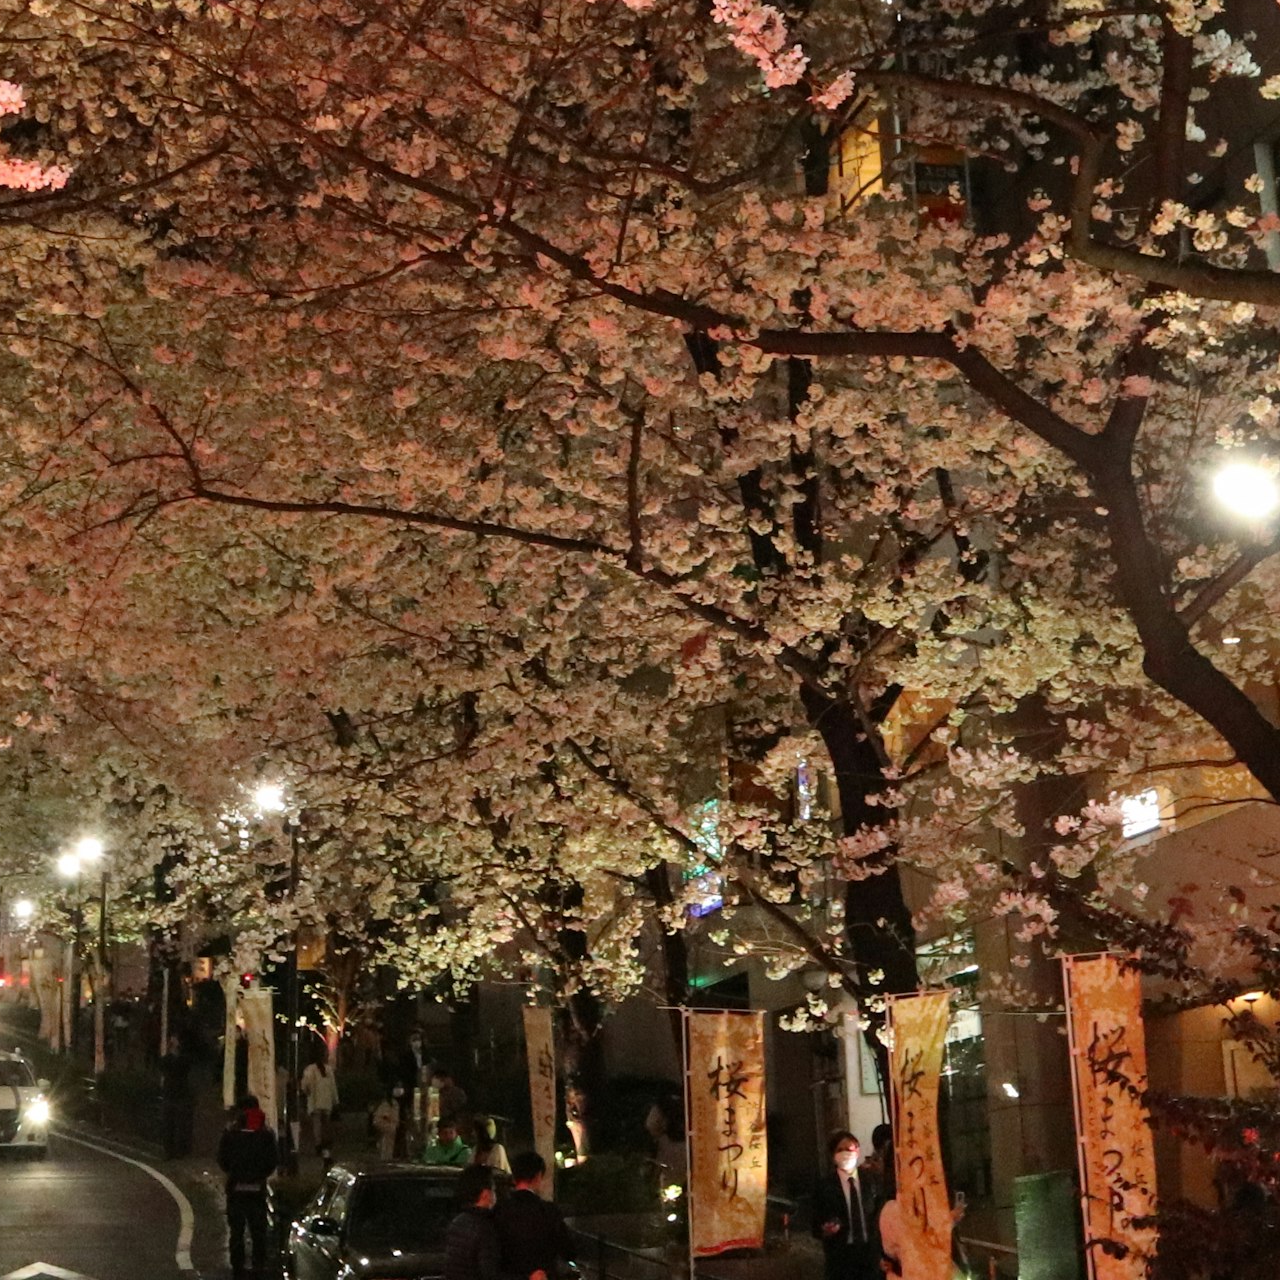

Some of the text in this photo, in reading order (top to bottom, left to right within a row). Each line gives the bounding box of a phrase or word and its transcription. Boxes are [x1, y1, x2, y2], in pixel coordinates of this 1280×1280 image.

[707, 1055, 749, 1202] 桜まつり
[902, 1048, 928, 1233] 桜まつり
